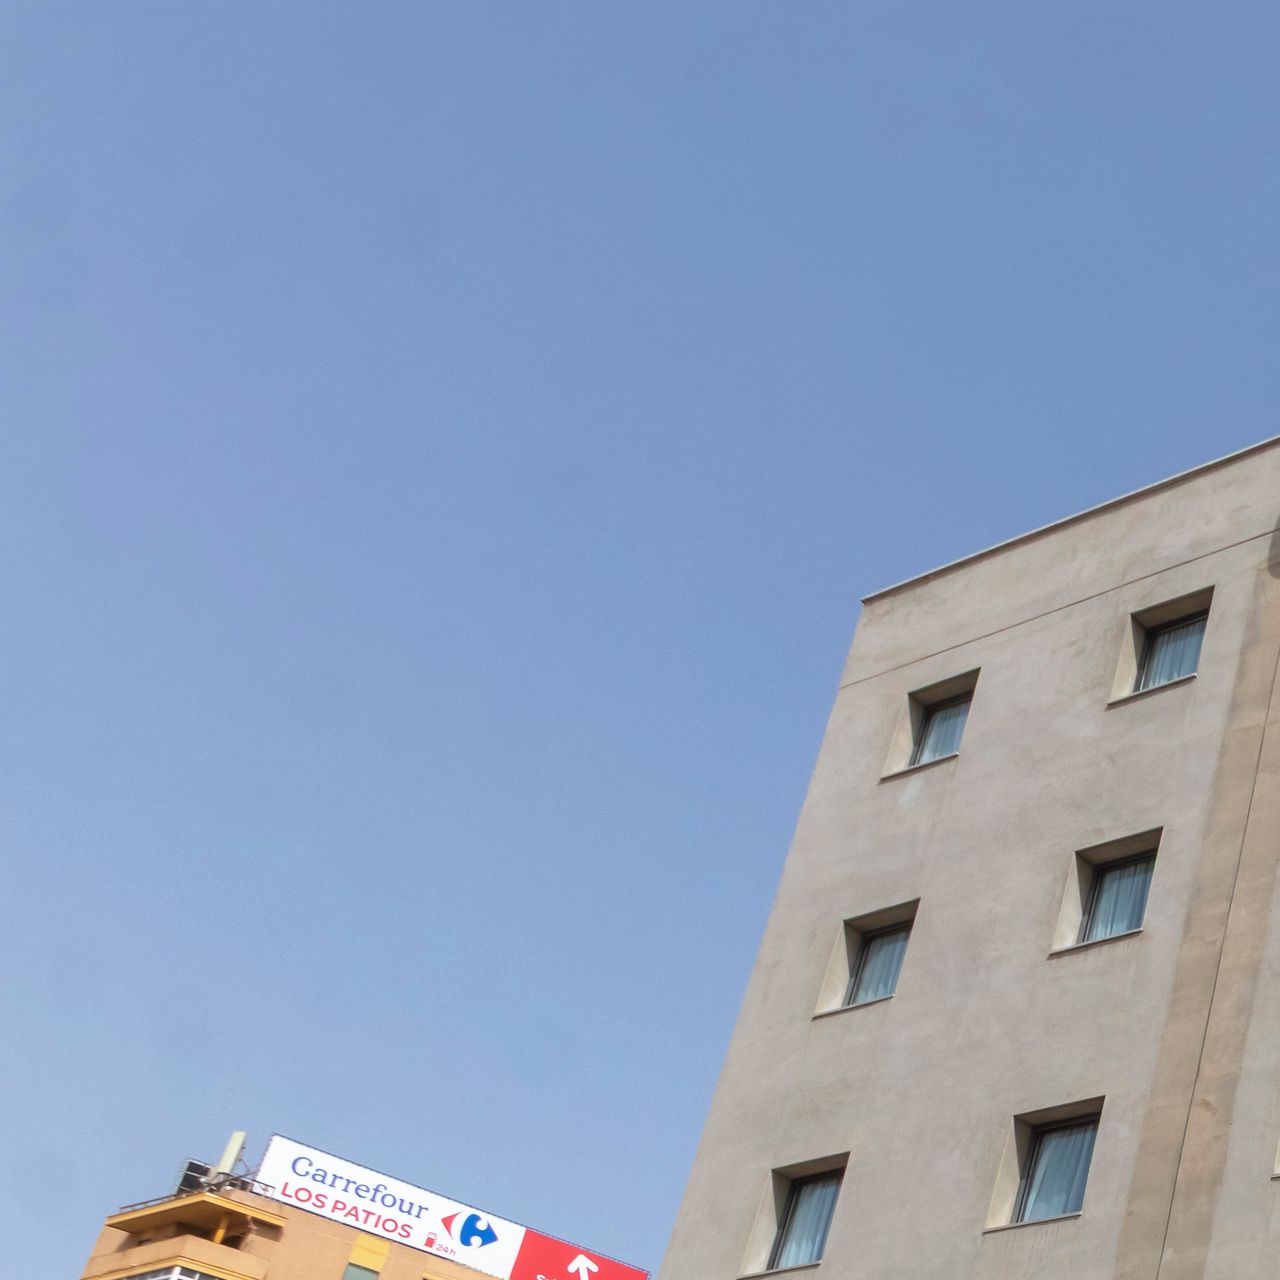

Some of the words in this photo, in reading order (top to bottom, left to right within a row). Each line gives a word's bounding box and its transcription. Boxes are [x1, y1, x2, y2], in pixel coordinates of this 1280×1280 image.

[281, 1182, 328, 1209] LOS
[331, 1199, 413, 1239] PATIOS
[291, 1156, 429, 1220] Carrefour
